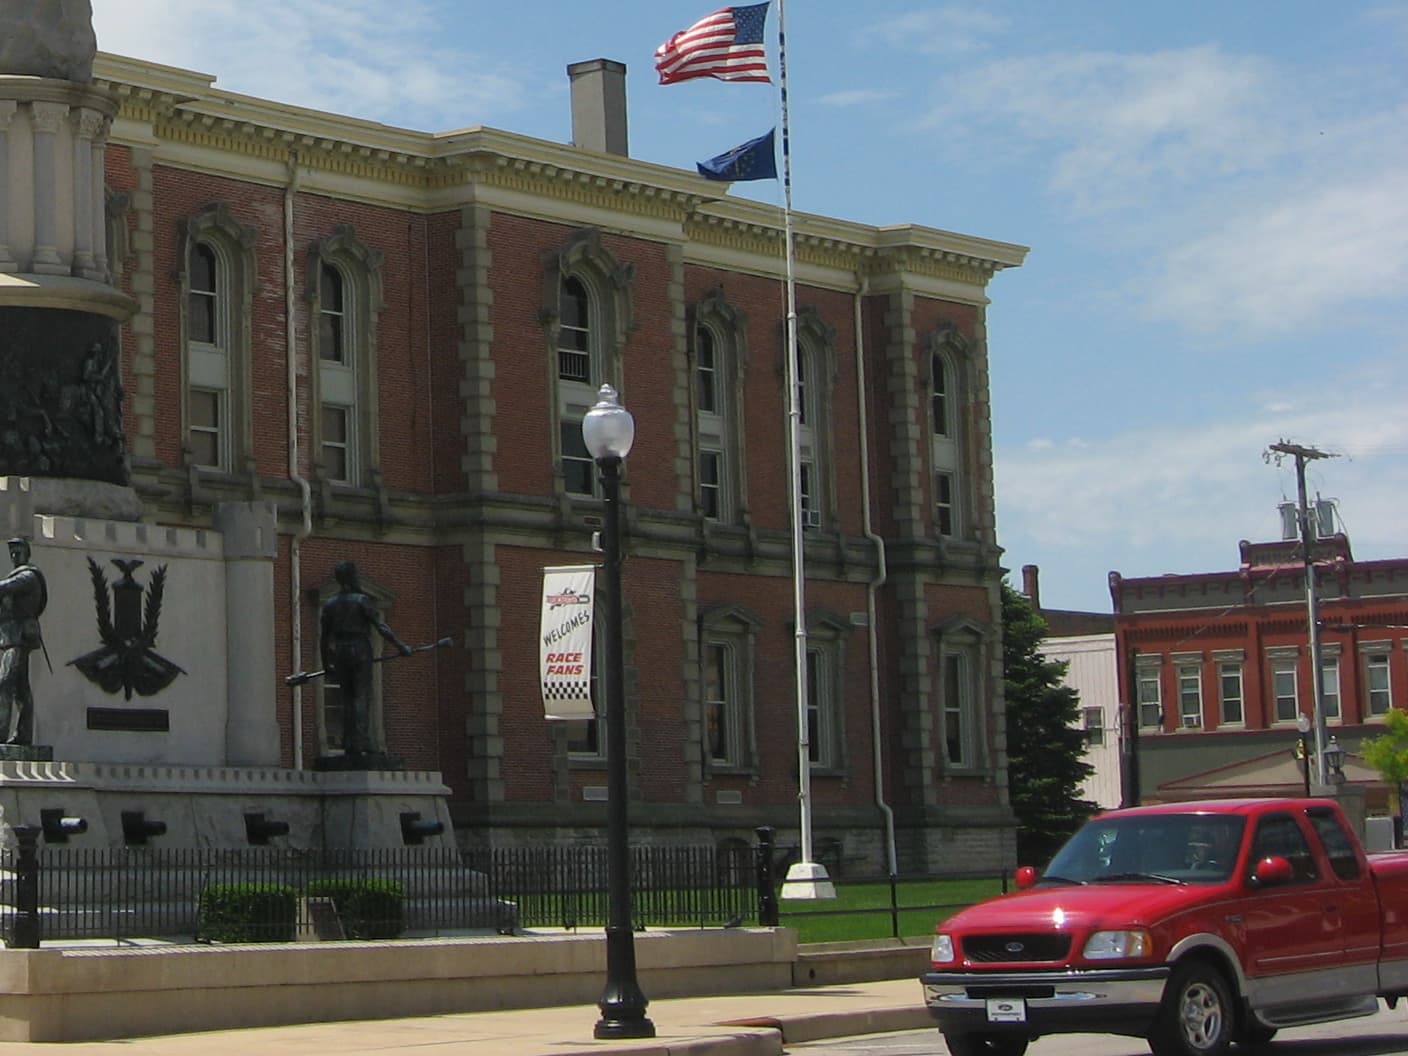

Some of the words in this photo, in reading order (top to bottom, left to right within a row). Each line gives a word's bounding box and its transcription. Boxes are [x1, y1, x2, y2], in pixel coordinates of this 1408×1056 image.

[543, 609, 590, 647] WELCOMES
[546, 652, 582, 663] RACE
[547, 664, 584, 675] FANS
